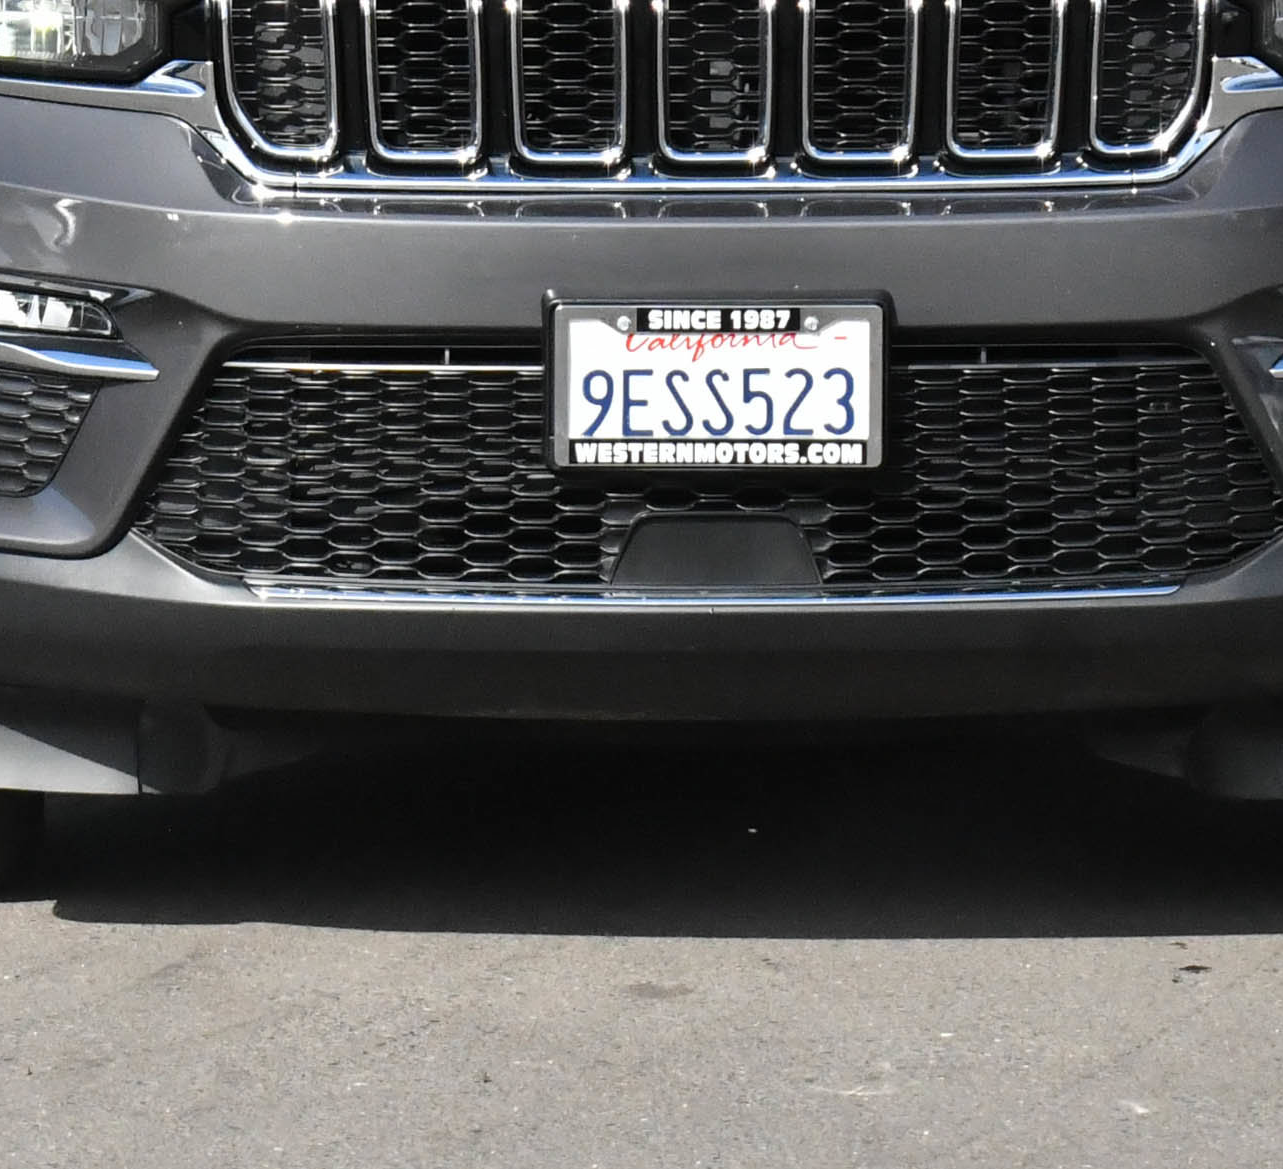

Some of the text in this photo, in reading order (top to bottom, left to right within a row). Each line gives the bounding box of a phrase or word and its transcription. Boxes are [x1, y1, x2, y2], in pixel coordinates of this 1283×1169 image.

[647, 309, 792, 331] SINCE 1987
[581, 368, 855, 437] 9ESS523
[574, 442, 863, 465] WESTERNMOTORS.COM
